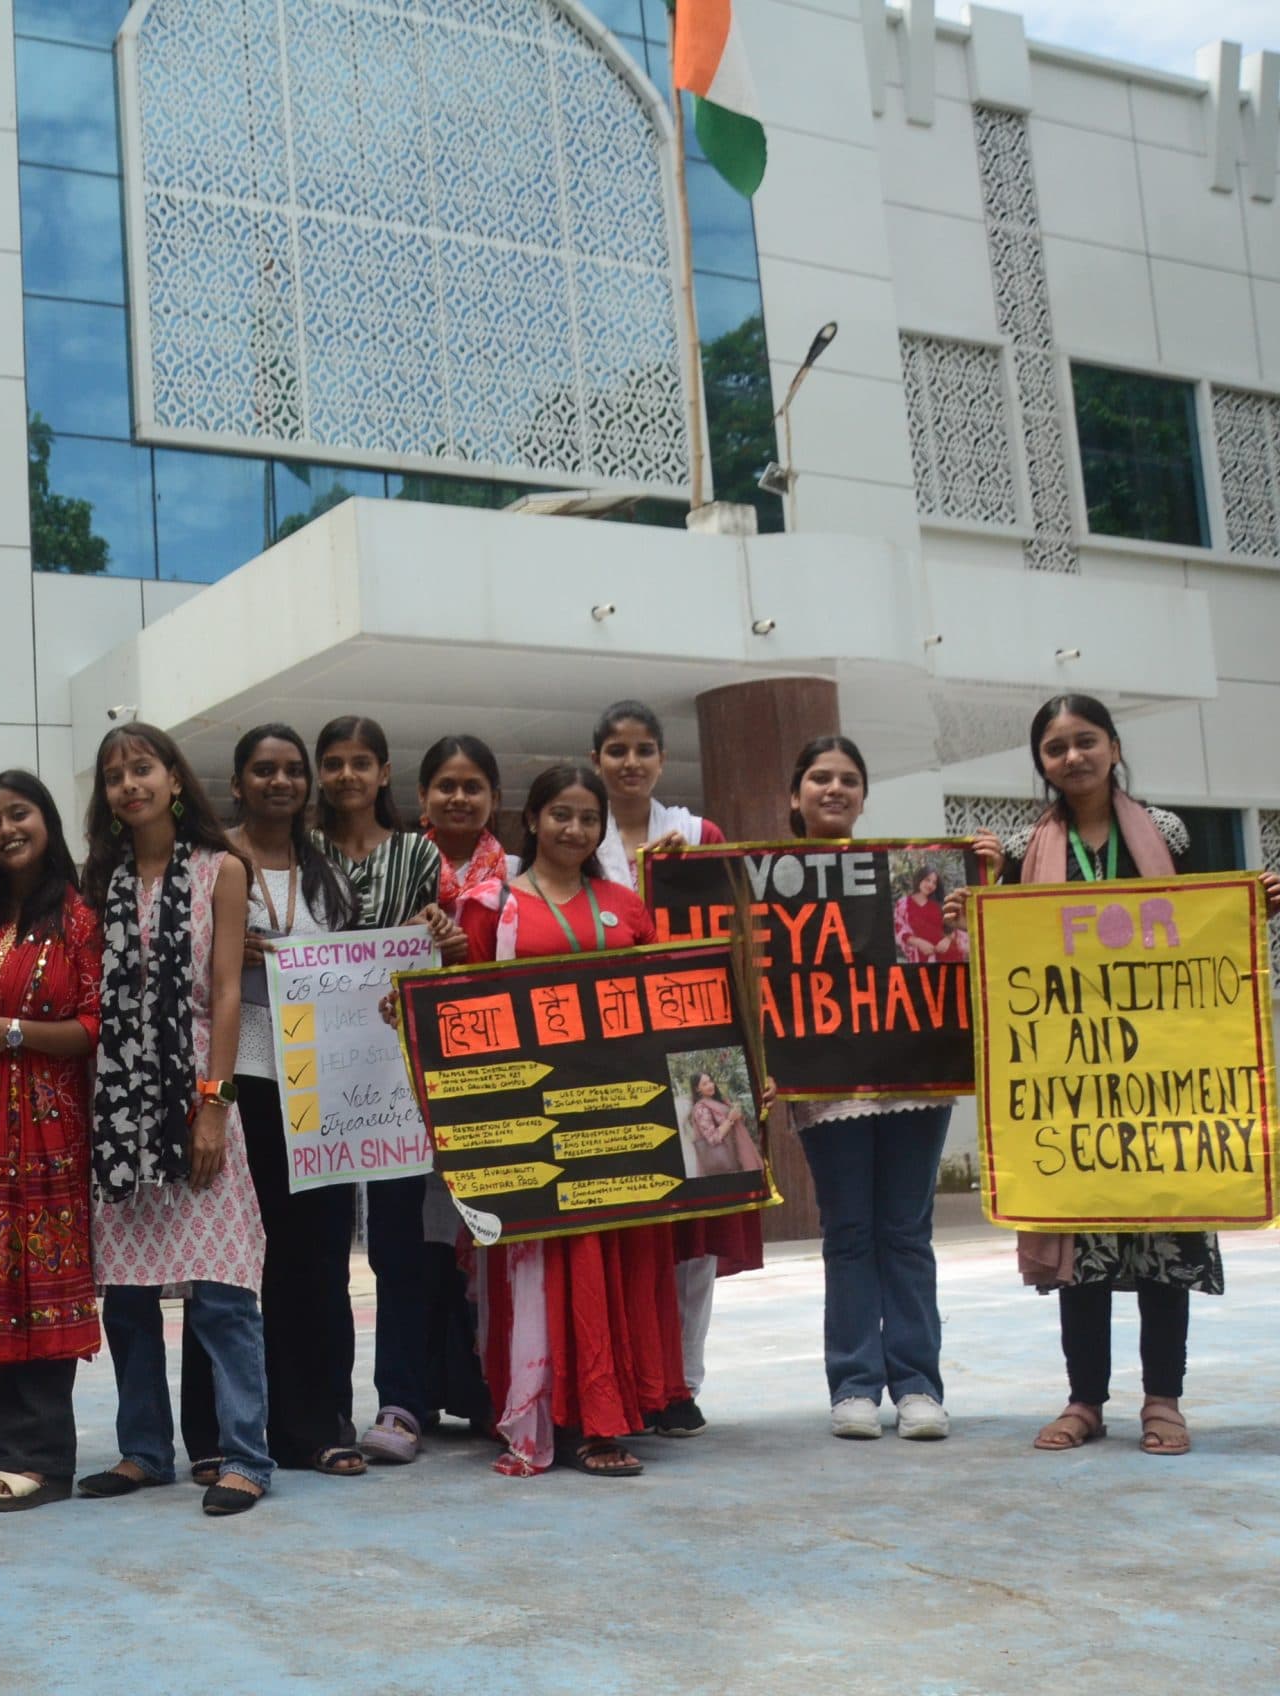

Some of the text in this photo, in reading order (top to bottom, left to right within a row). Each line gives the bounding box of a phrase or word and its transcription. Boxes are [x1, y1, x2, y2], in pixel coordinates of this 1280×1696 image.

[744, 852, 878, 901] VOTE
[277, 937, 433, 970] ELECTION 2024
[1058, 898, 1181, 957] FOR
[286, 974, 313, 1001] To
[760, 965, 970, 1039] AIBHAVI
[439, 1002, 502, 1055] हिया
[538, 987, 570, 1036] है
[602, 981, 636, 1030] तो
[1008, 1016, 1140, 1065] N AND
[1008, 1066, 1260, 1122] ENVIRONMENT
[293, 1132, 434, 1178] PRIYA SINHA
[1033, 1117, 1257, 1176] SECRETARY
